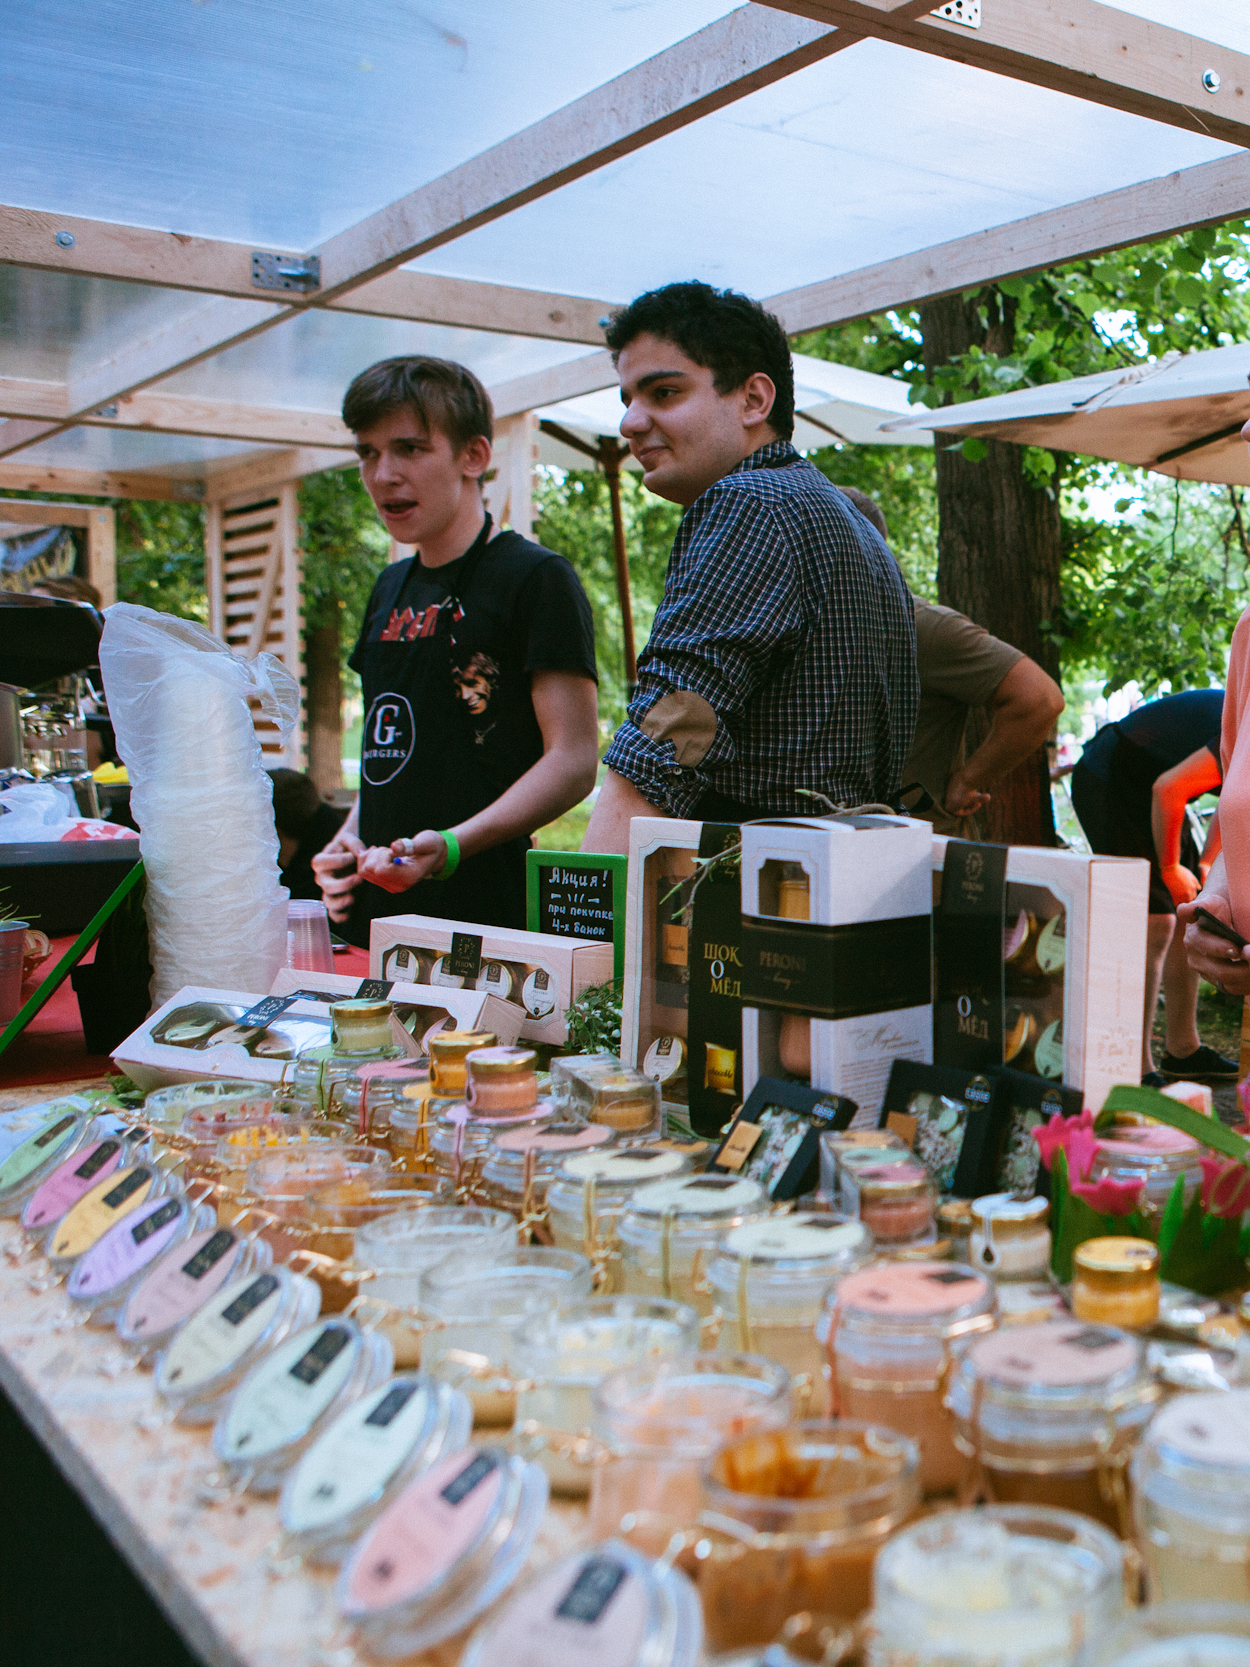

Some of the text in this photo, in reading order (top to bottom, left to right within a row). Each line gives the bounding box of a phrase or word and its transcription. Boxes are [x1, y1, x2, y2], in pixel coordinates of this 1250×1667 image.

[548, 904, 566, 916] при
[573, 921, 606, 936] банок
[704, 943, 744, 967] ШОК
[709, 977, 742, 998] МЁД
